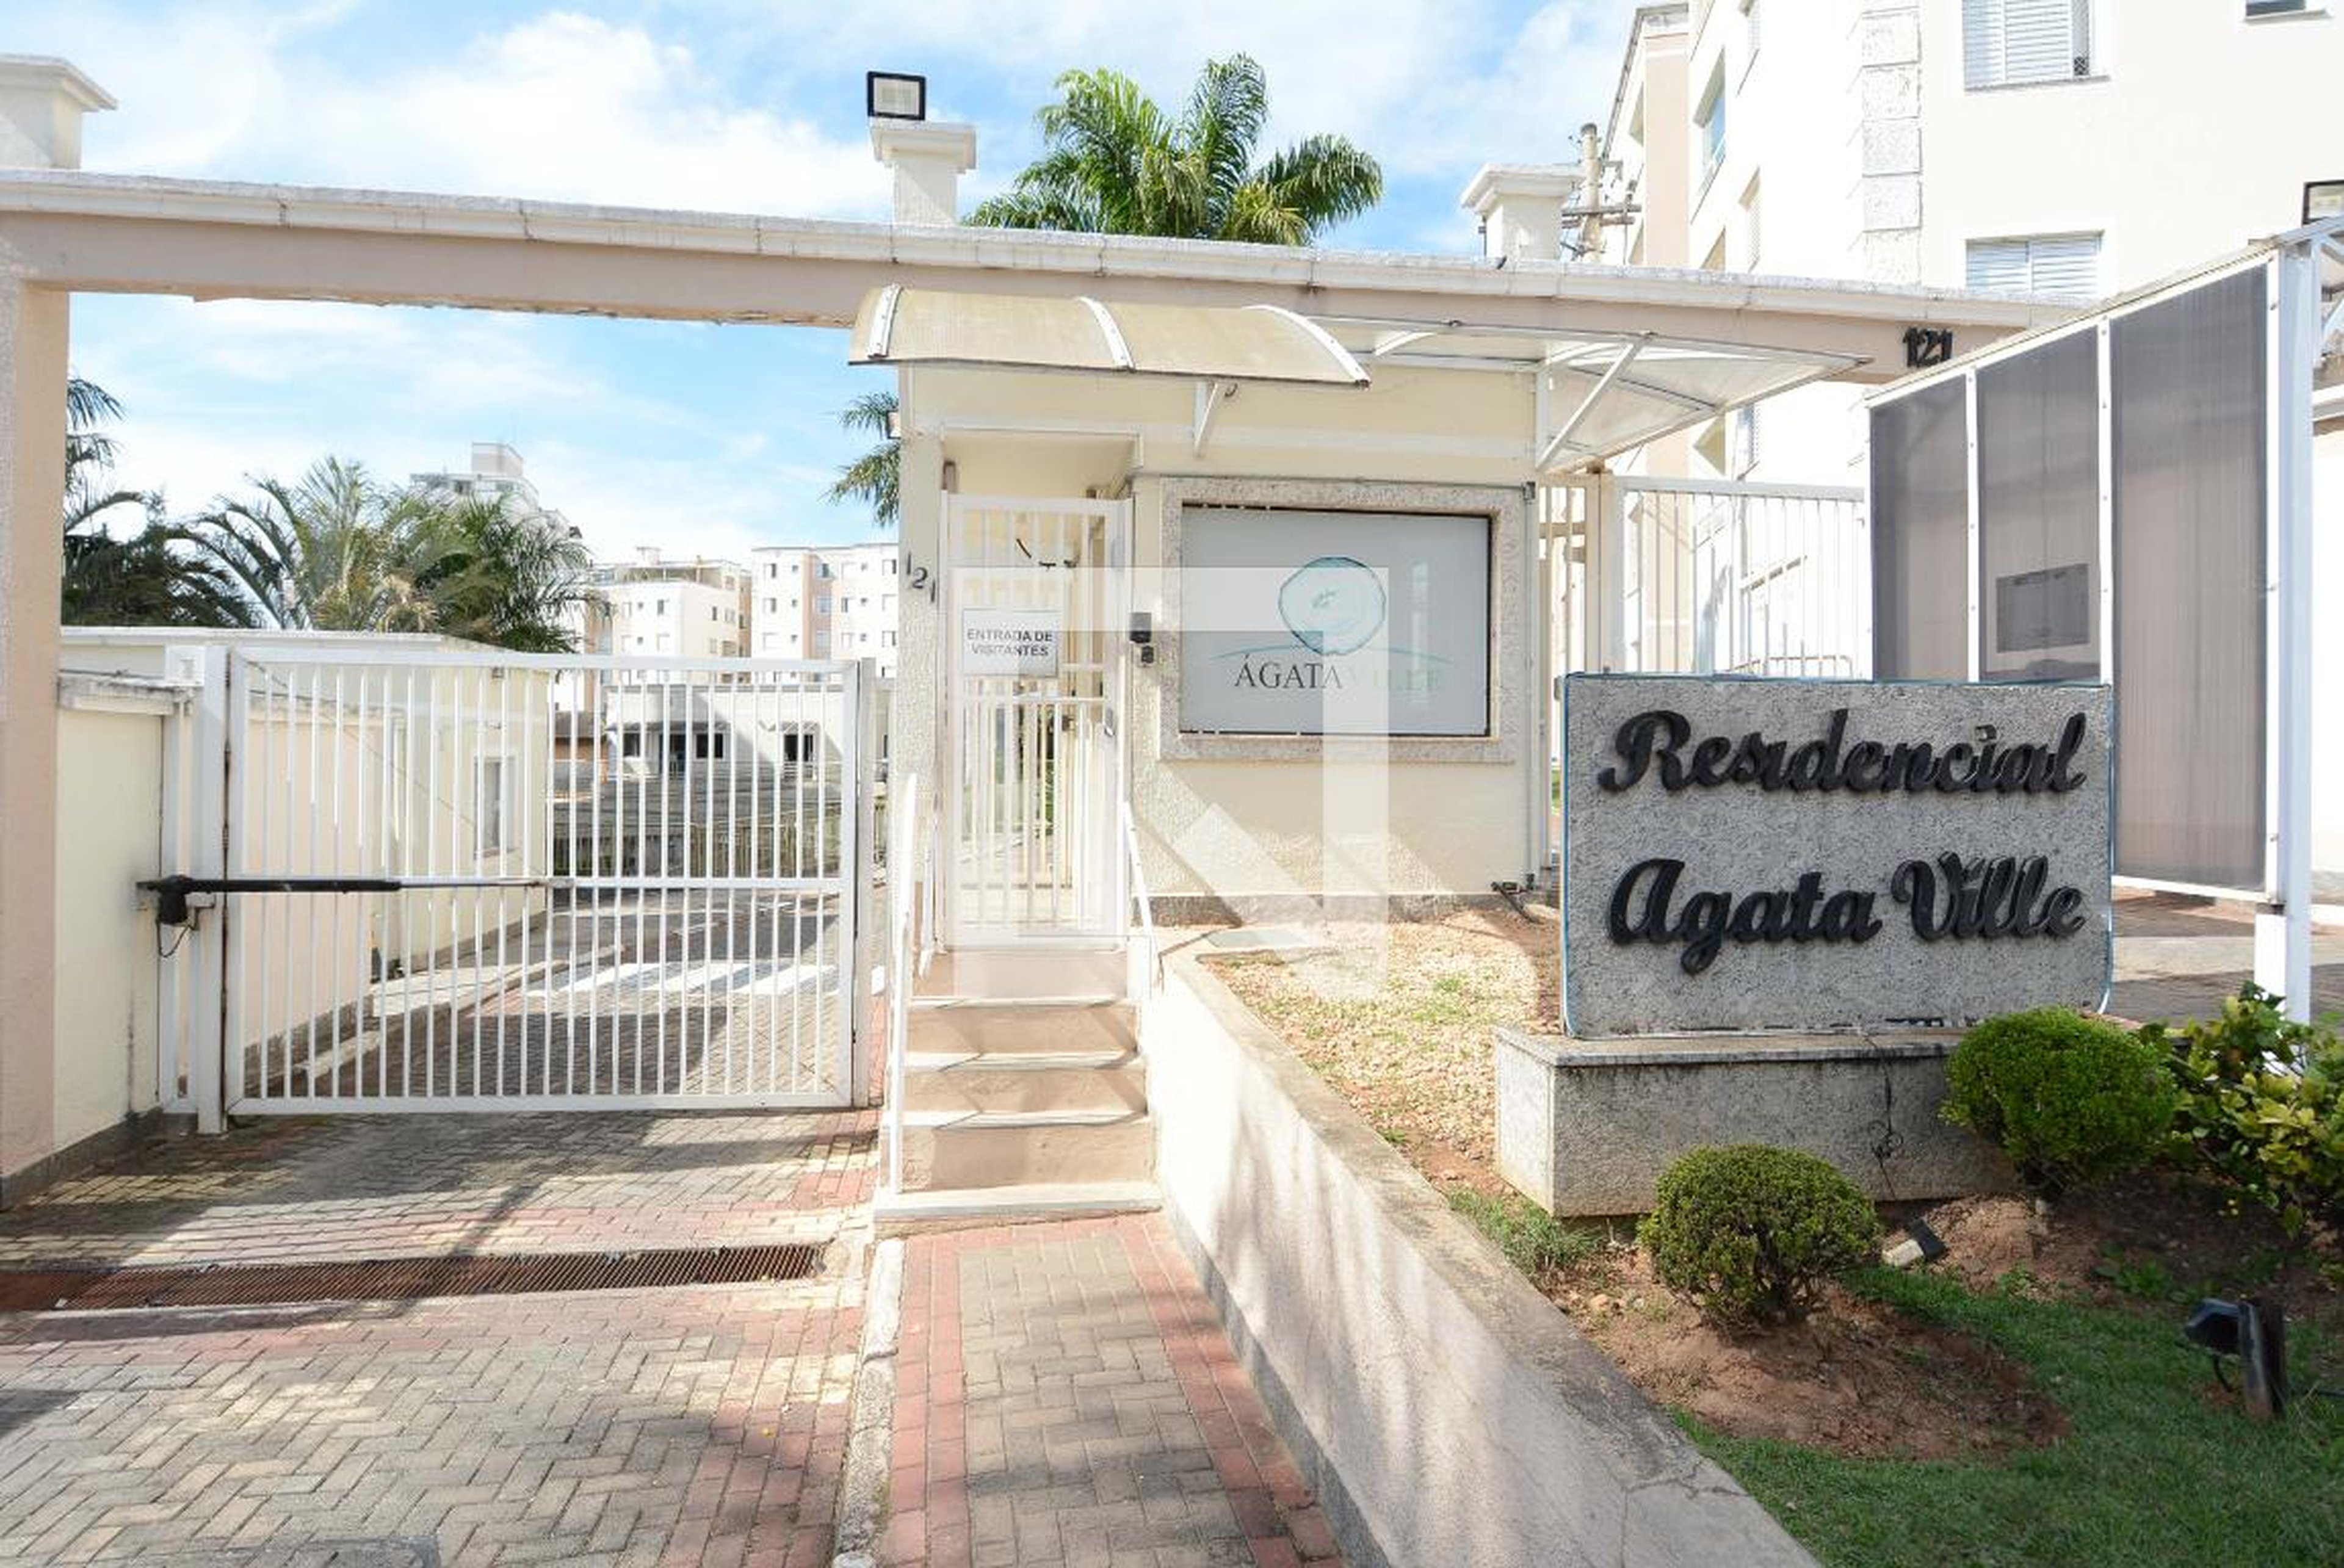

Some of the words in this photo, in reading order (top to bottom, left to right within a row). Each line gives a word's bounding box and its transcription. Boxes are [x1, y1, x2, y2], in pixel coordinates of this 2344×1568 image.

[1902, 327, 1952, 368] 121
[906, 552, 936, 603] 121
[967, 629, 1032, 641] ENTRADA
[1035, 630, 1053, 641] DE
[971, 644, 1049, 656] VISITANTES
[1235, 654, 1342, 688] ÁGATA
[1597, 707, 2087, 795] Residencial
[1607, 858, 1883, 975] Agata
[1890, 853, 2087, 941] Ville
